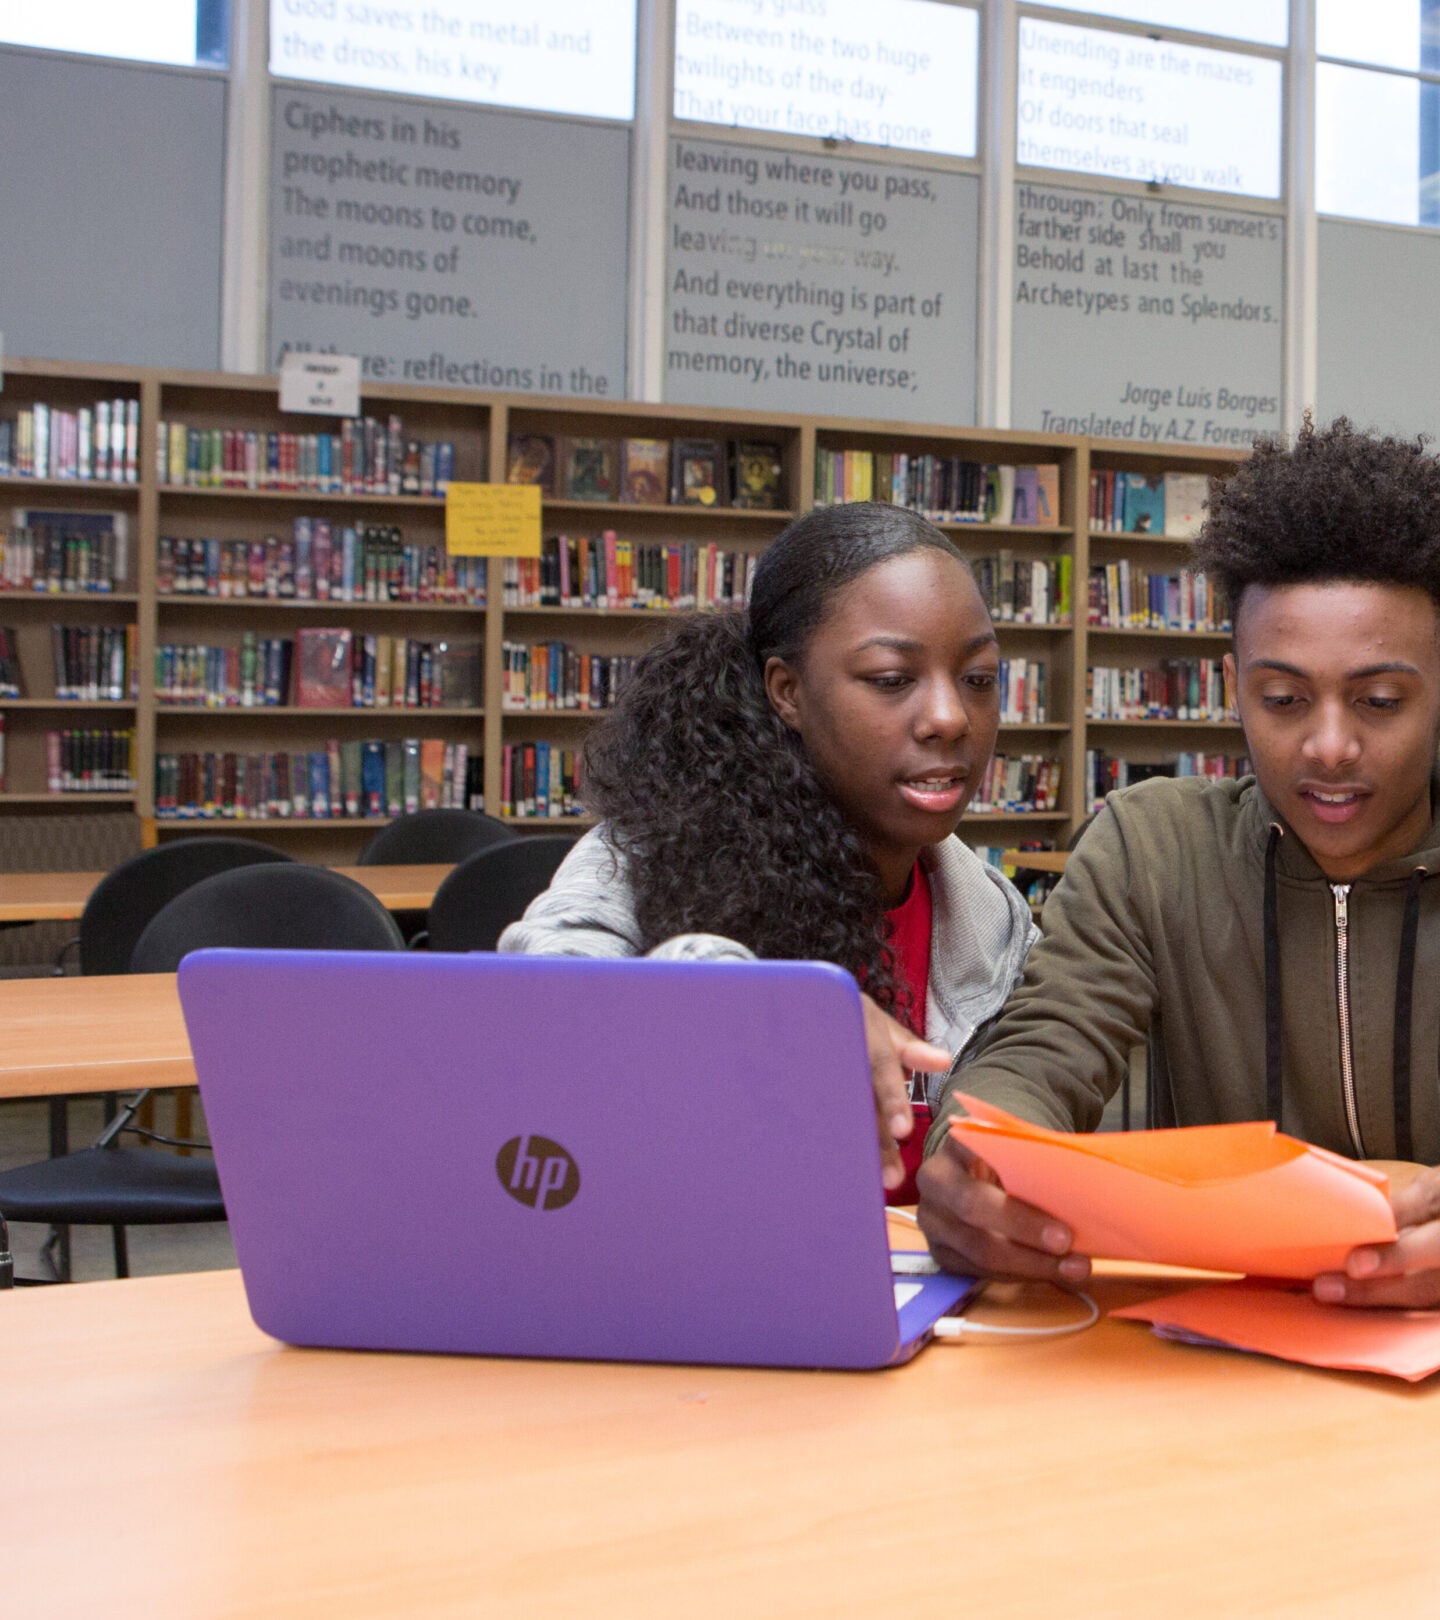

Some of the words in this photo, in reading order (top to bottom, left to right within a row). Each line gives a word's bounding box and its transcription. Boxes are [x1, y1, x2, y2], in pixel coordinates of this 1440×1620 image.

[345, 1, 415, 30] saves
[421, 5, 461, 36] the
[468, 16, 540, 46] metal
[545, 23, 592, 52] and
[686, 10, 784, 49] Between
[790, 26, 825, 55] the
[831, 34, 871, 61] two
[876, 36, 932, 72] huge
[675, 51, 775, 87] twilights
[780, 63, 801, 90] of
[808, 67, 844, 96] the
[850, 71, 888, 106] day
[1020, 26, 1120, 69] Unending
[1125, 48, 1155, 71] are
[1160, 50, 1192, 77] the
[1195, 59, 1255, 87] mazes
[1020, 63, 1035, 88] it
[1040, 71, 1146, 104] engenders
[284, 102, 385, 141] Ciphers
[391, 115, 416, 145] in
[423, 118, 462, 150] his
[1020, 99, 1045, 125] Of
[1049, 103, 1104, 134] doors
[1109, 112, 1149, 140] that
[1151, 121, 1189, 145] seal
[283, 149, 409, 185] prophetic
[414, 165, 522, 203] memory
[674, 143, 759, 184] leaving
[765, 156, 834, 189] where
[838, 171, 879, 196] you
[884, 177, 937, 205] pass,
[281, 186, 329, 220] The
[336, 200, 424, 230] moons
[431, 207, 457, 234] to
[462, 213, 538, 246] come,
[674, 181, 721, 213] And
[726, 189, 789, 221] those
[794, 197, 810, 223] it
[814, 200, 853, 229] will
[858, 210, 888, 236] go
[1110, 196, 1155, 229] Only
[1159, 203, 1204, 232] from
[1207, 215, 1279, 242] sunset's
[279, 232, 332, 262] and
[338, 242, 427, 271] moons
[432, 245, 460, 274] of
[1018, 213, 1081, 243] farther
[1087, 223, 1126, 248] side
[1138, 227, 1182, 255] shall
[1193, 238, 1227, 261] you
[853, 249, 901, 276] way.
[1015, 243, 1085, 274] Behold
[1095, 256, 1114, 277] at
[1122, 254, 1160, 282] last
[1170, 261, 1204, 287] the
[278, 280, 399, 316] evenings
[404, 292, 479, 320] gone.
[672, 266, 719, 297] And
[725, 279, 845, 314] everything
[850, 285, 868, 312] is
[873, 294, 916, 318] part
[920, 293, 944, 320] of
[1015, 280, 1131, 315] Archetypes
[1137, 292, 1175, 317] and
[1180, 294, 1279, 325] Splendors.
[672, 308, 718, 337] that
[723, 311, 805, 344] diverse
[809, 319, 883, 352] Crystal
[887, 326, 910, 353] of
[403, 353, 534, 390] reflections
[539, 363, 564, 392] in
[569, 366, 609, 396] the
[668, 349, 771, 381] memory,
[775, 353, 812, 381] the
[817, 358, 919, 393] universe;
[1119, 382, 1173, 411] Jorge
[1176, 386, 1213, 410] Luis
[1216, 388, 1279, 417] Borges
[1041, 409, 1136, 437] Translated
[1139, 416, 1162, 443] by
[510, 1134, 568, 1211] hp
